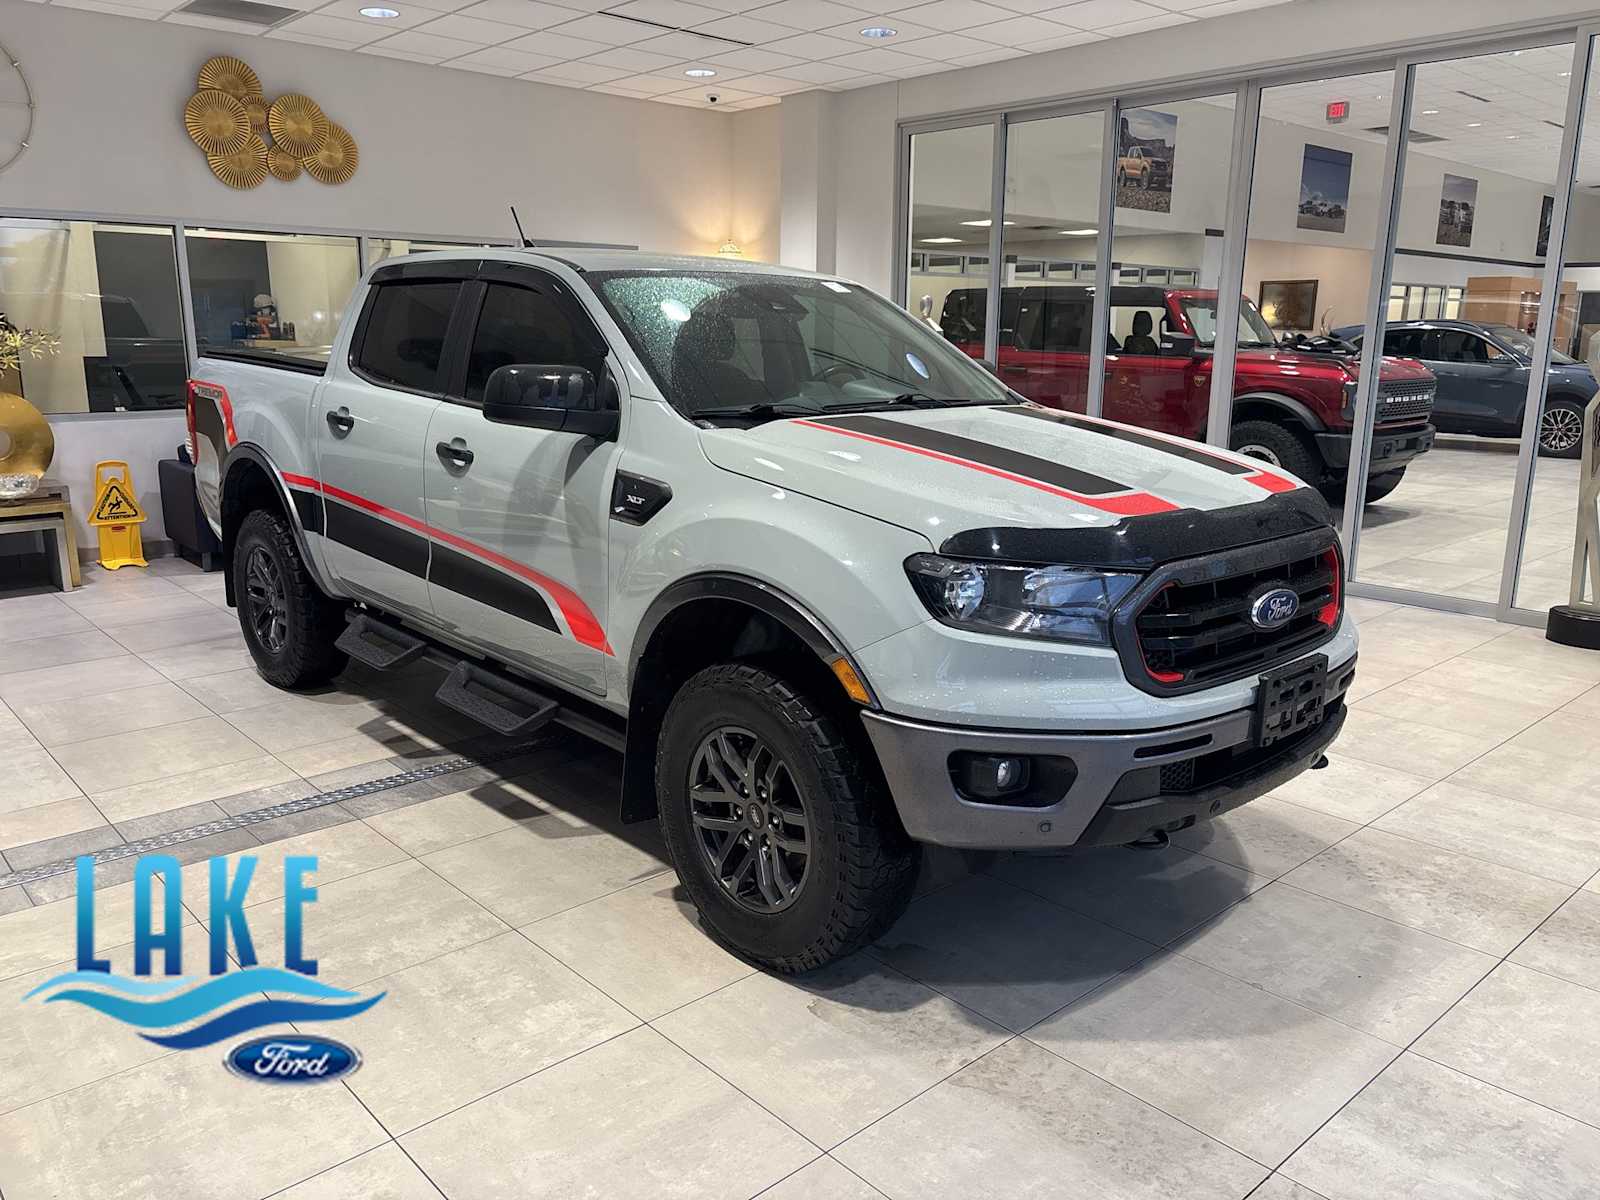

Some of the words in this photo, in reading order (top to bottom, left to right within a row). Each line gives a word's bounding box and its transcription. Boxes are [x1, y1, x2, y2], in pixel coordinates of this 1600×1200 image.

[1328, 103, 1345, 117] EXIT
[1386, 394, 1430, 403] BRONCO
[626, 494, 646, 505] XLT
[1267, 596, 1293, 621] Ford
